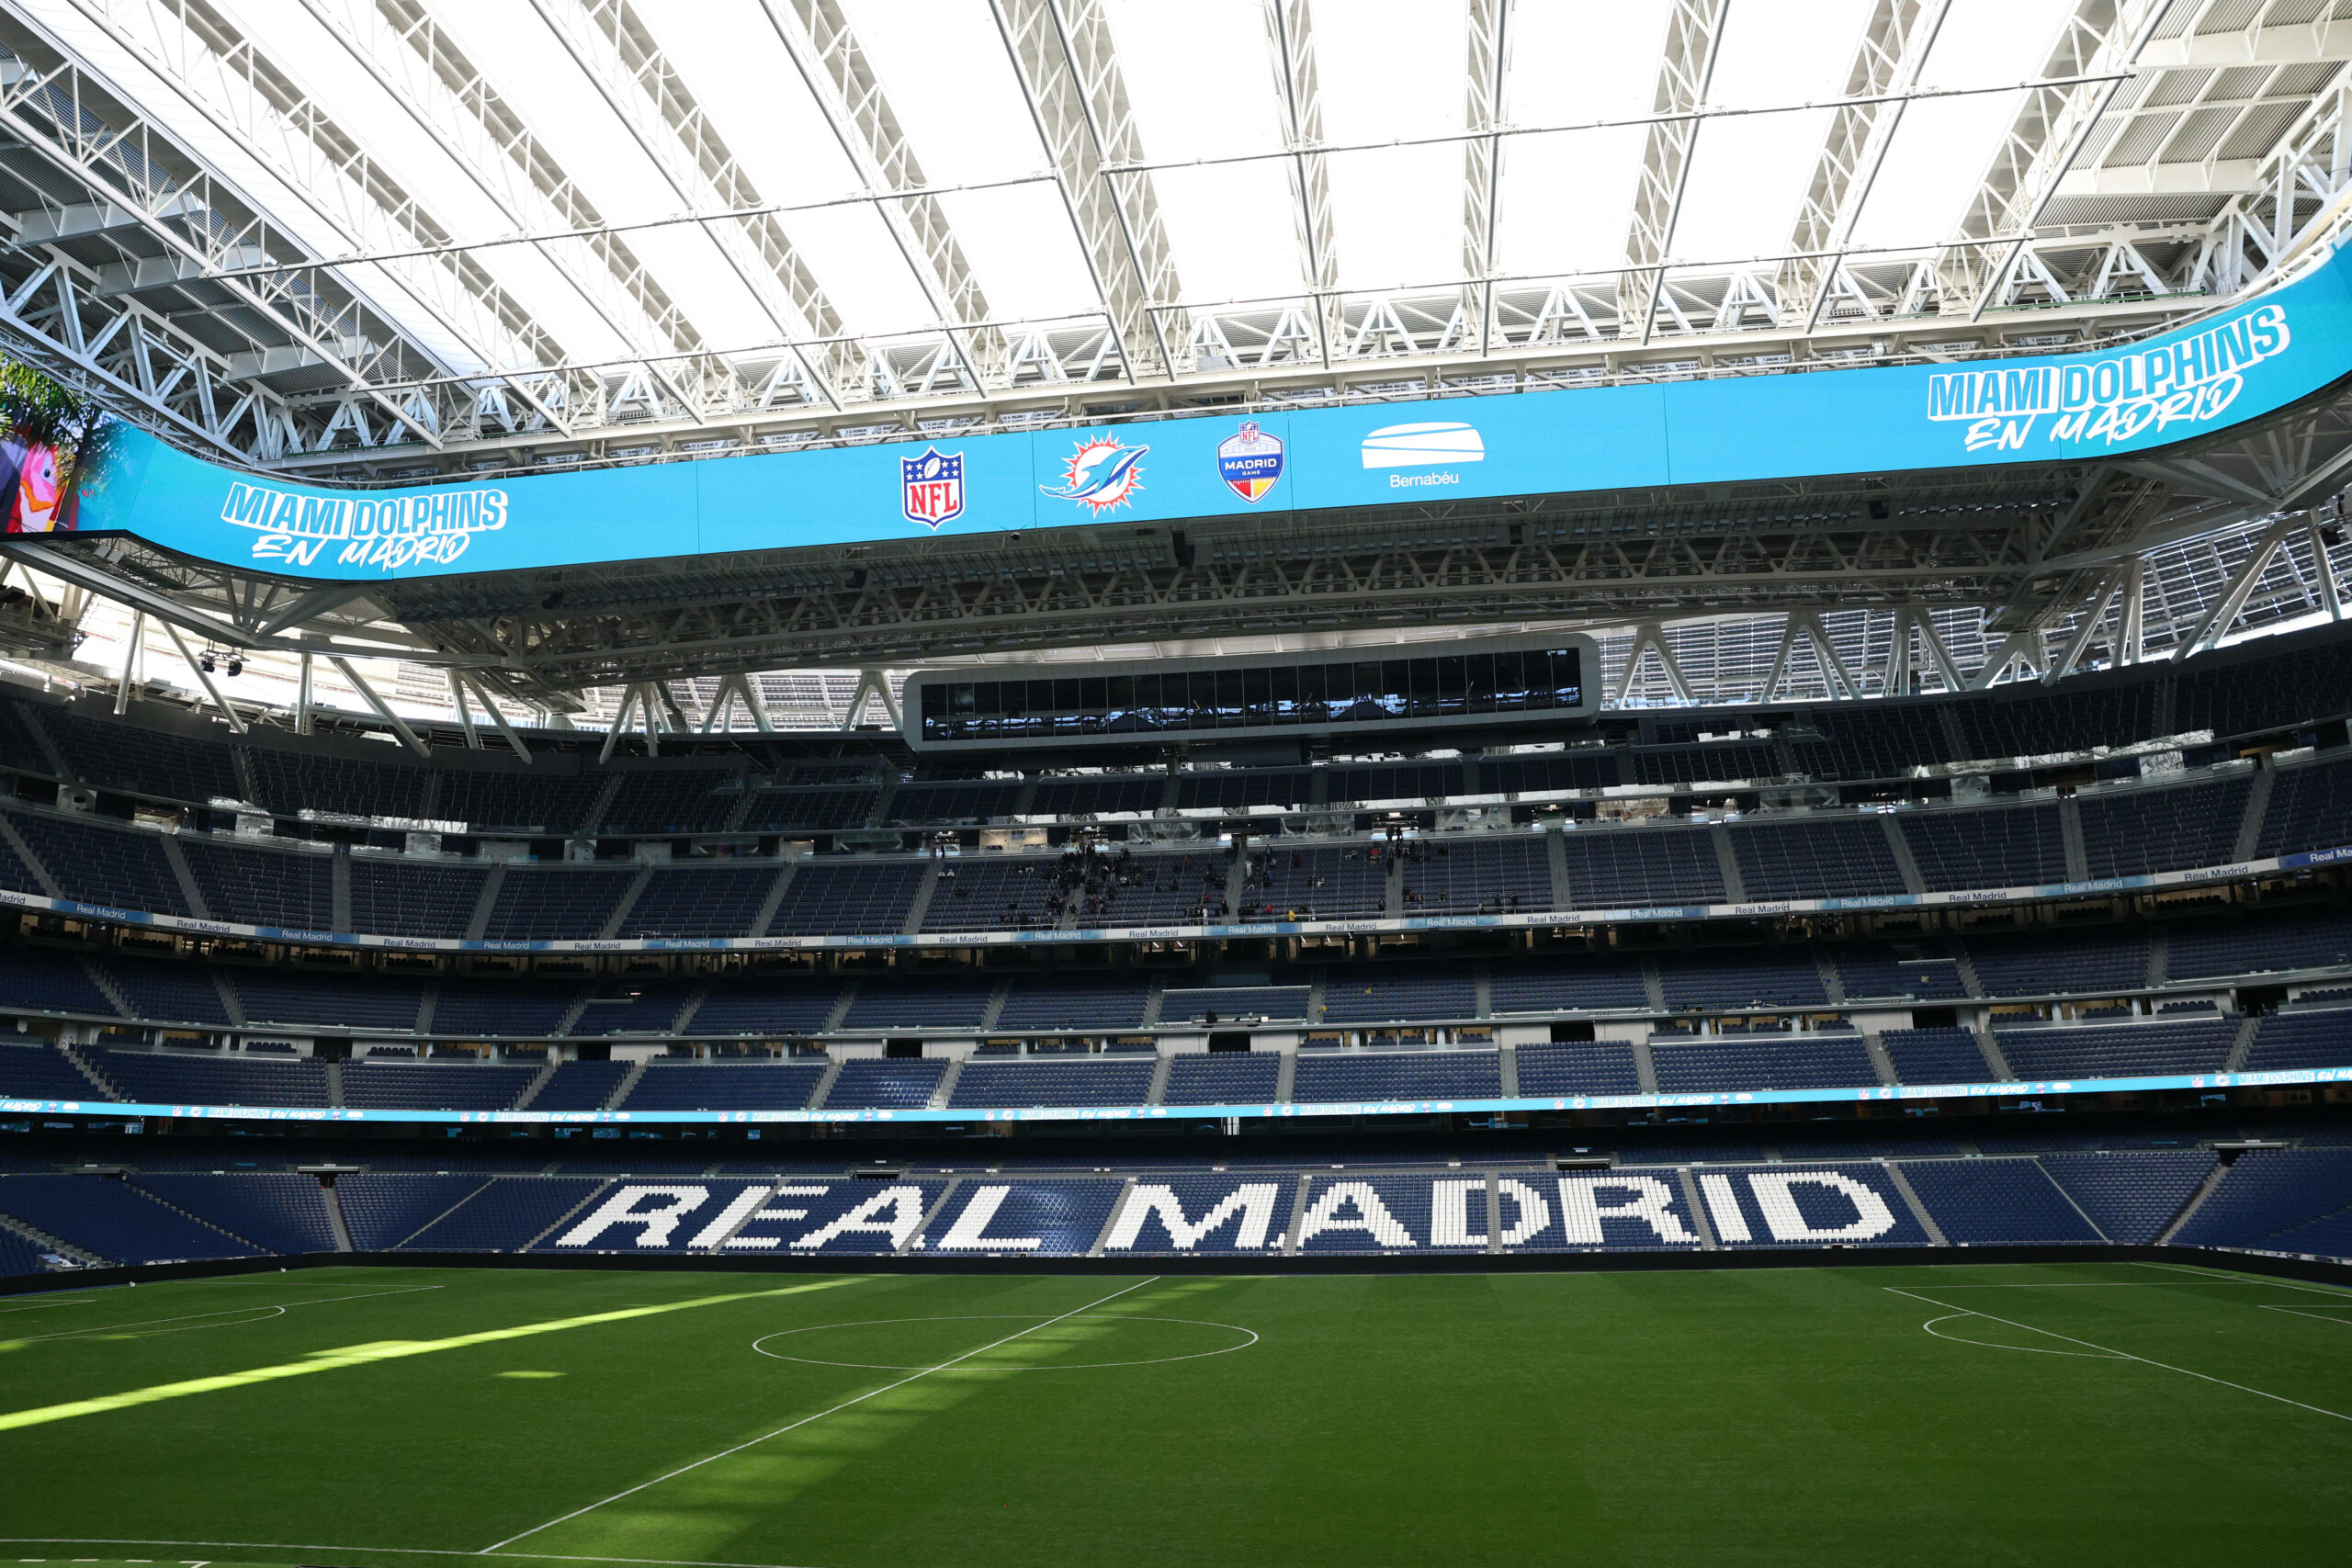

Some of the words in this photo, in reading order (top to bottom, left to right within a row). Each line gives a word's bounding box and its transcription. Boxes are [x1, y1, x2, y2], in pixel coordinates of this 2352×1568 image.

[1927, 366, 2061, 421] MIAMI
[2060, 305, 2291, 412] DOLPHINS
[1964, 413, 2035, 452] EN
[2050, 375, 2243, 446] MADRID
[1242, 431, 1258, 442] NFL
[1225, 458, 1277, 471] MADRID
[1389, 470, 1459, 488] Bernabéu
[910, 482, 957, 517] NFL
[220, 481, 350, 539] MIAMI
[351, 489, 508, 539] DOLPHINS
[252, 533, 326, 566] EN
[338, 531, 470, 572] MADRID
[2310, 853, 2334, 863] Real
[2184, 873, 2208, 882] Real
[2211, 865, 2248, 879] Madrid
[2064, 885, 2086, 893] Real
[2088, 880, 2123, 891] Madrid
[1840, 899, 1860, 908] Real
[1863, 897, 1894, 906] Madrid
[1973, 892, 2007, 901] Madrid
[77, 904, 95, 914] Real
[96, 907, 126, 919] Madrid
[1653, 908, 1683, 917] Madrid
[1758, 905, 1790, 913] Madrid
[177, 919, 196, 929] Real
[199, 922, 230, 933] Madrid
[1527, 916, 1546, 924] Real
[282, 931, 300, 939] Real
[303, 932, 333, 942] Madrid
[959, 935, 988, 943] Madrid
[1054, 931, 1081, 940] Madrid
[384, 939, 402, 947] Real
[406, 940, 435, 948] Madrid
[503, 942, 529, 950] Madrid
[684, 940, 709, 948] Madrid
[2237, 1073, 2267, 1086] MIAMI
[2267, 1071, 2315, 1084] DOLPHINS
[556, 1185, 1042, 1249] REAL
[1105, 1171, 1896, 1250] MADRID
